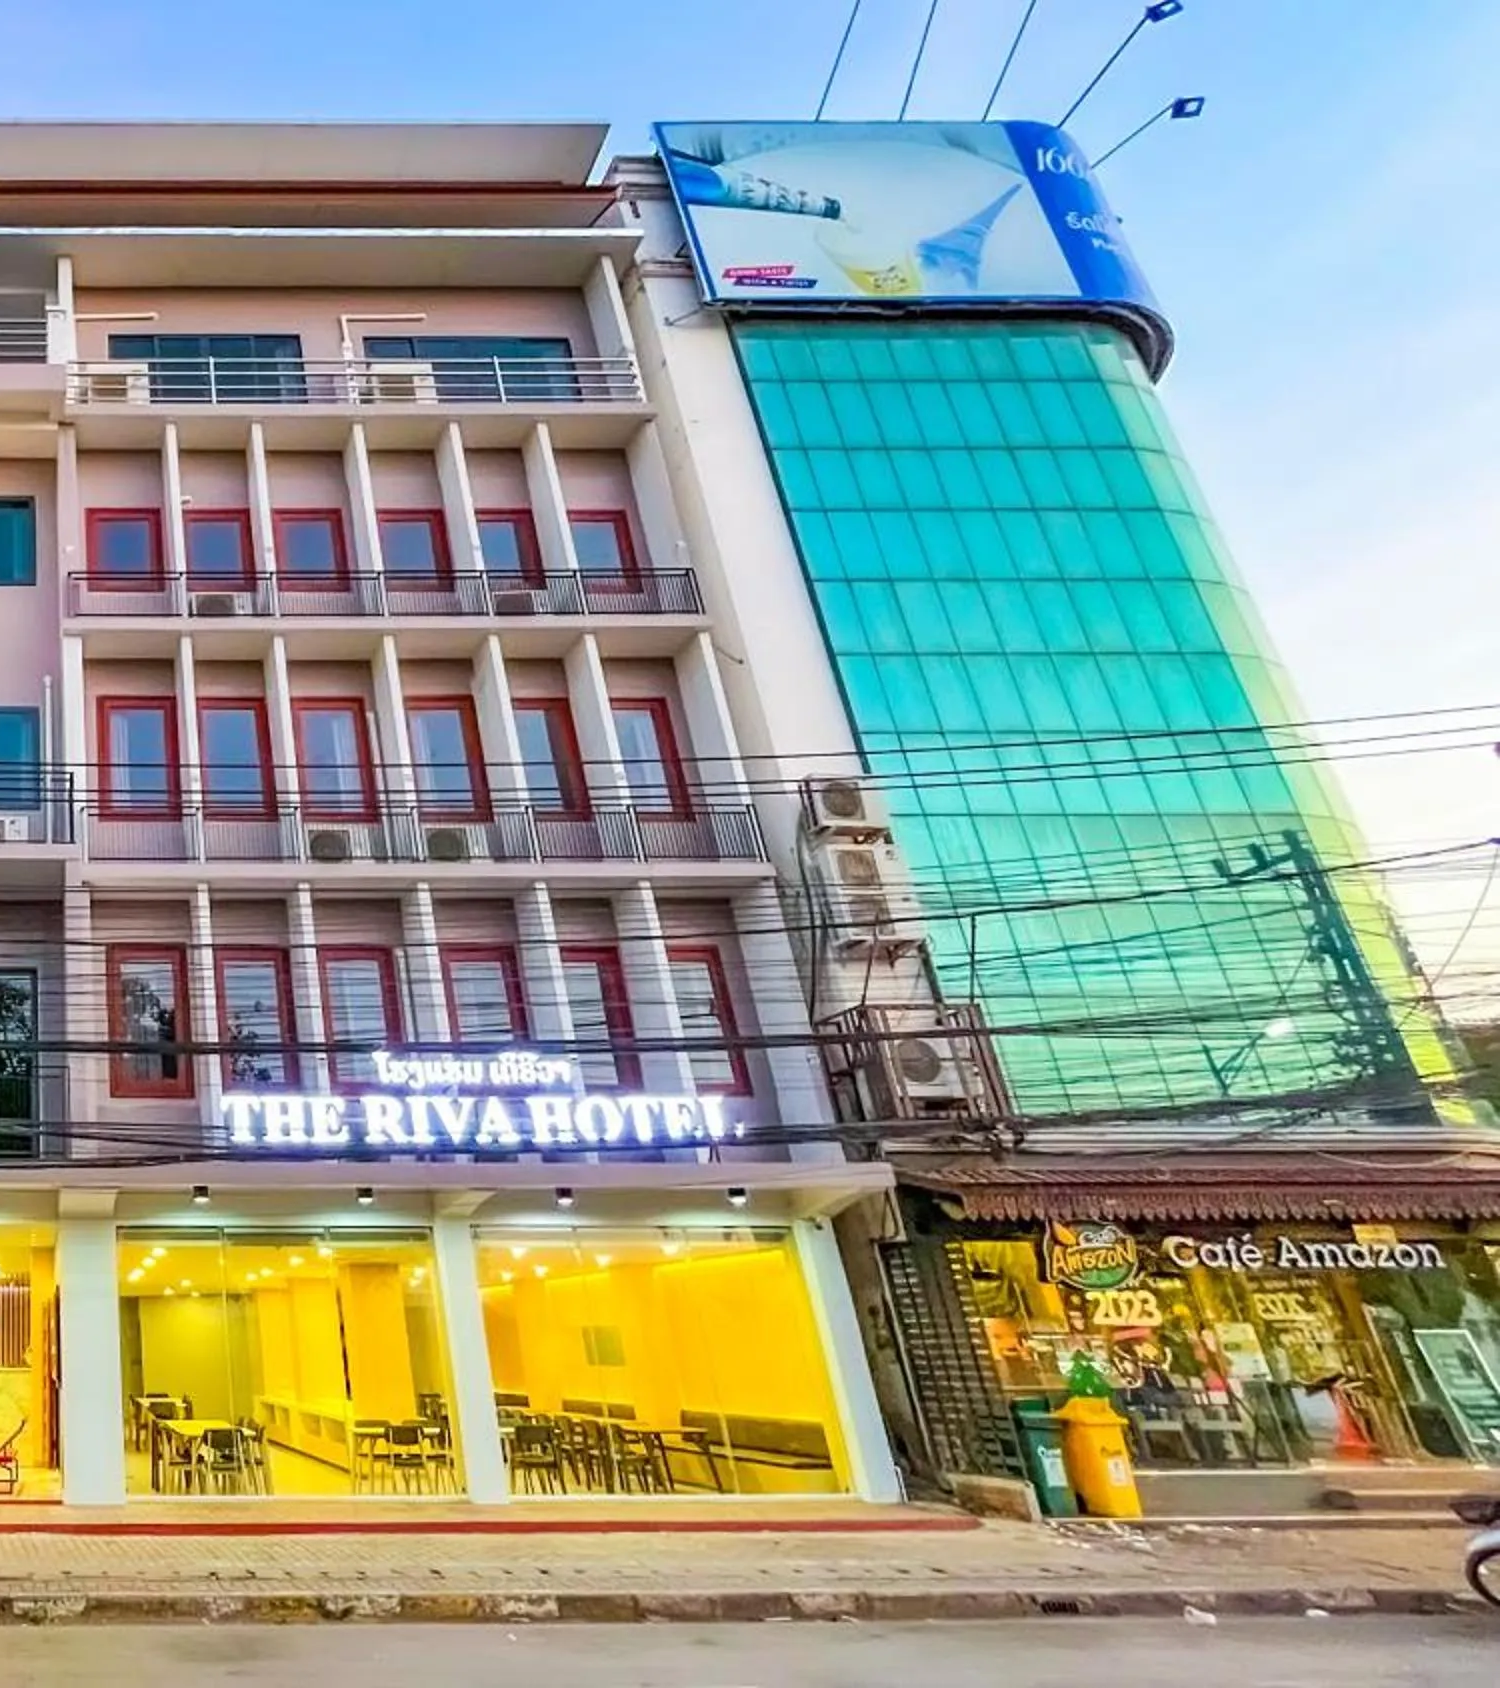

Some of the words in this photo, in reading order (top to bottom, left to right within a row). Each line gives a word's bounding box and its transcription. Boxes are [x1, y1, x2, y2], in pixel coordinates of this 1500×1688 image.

[220, 1095, 350, 1143] THE
[360, 1095, 520, 1143] RIVA
[524, 1095, 745, 1142] HOTEL
[1162, 1232, 1264, 1272] Café
[1277, 1235, 1447, 1268] Amazon
[1085, 1289, 1163, 1327] 2023
